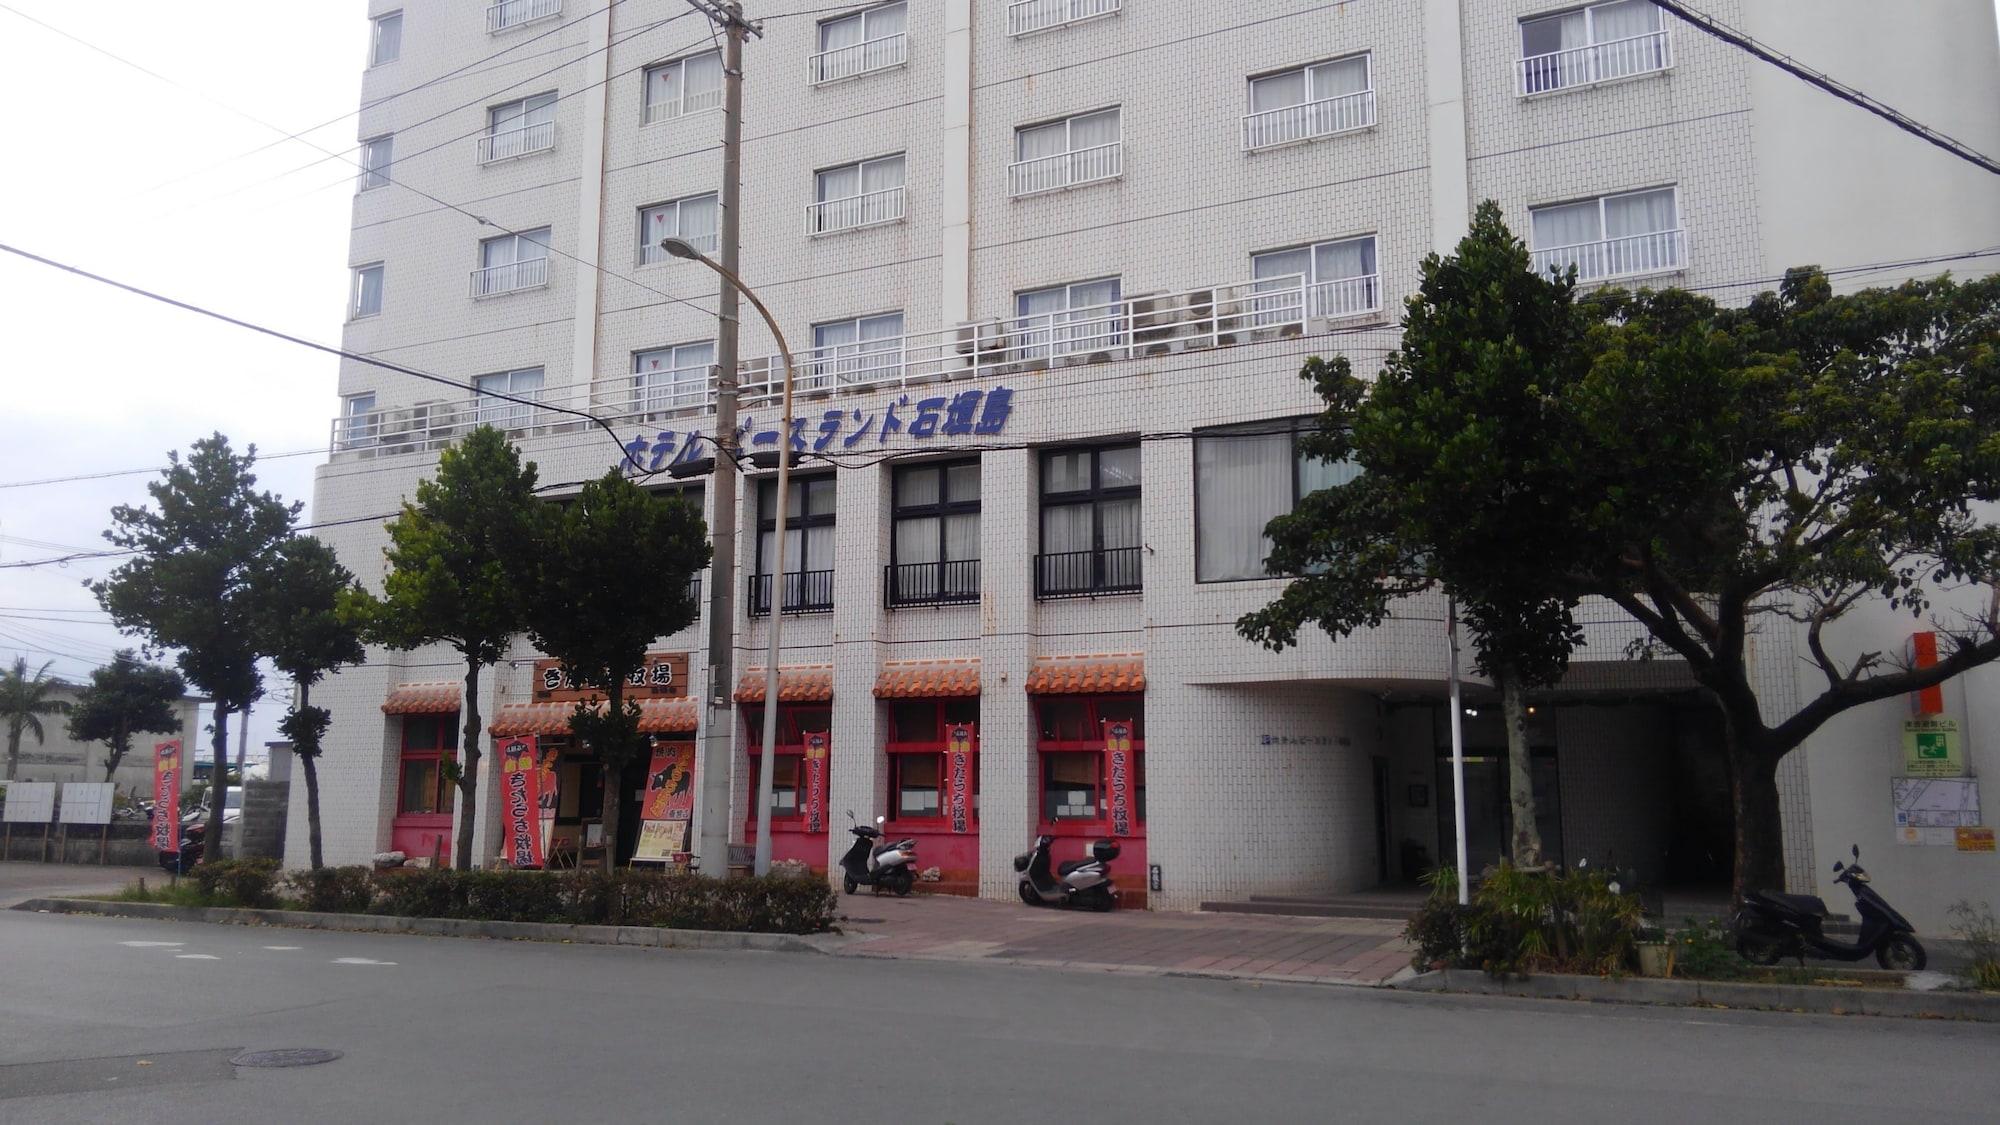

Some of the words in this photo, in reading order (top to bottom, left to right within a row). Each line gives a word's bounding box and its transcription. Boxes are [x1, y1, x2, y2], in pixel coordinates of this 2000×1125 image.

[543, 663, 673, 690] き牧場
[1112, 751, 1130, 837] きたうち牧場
